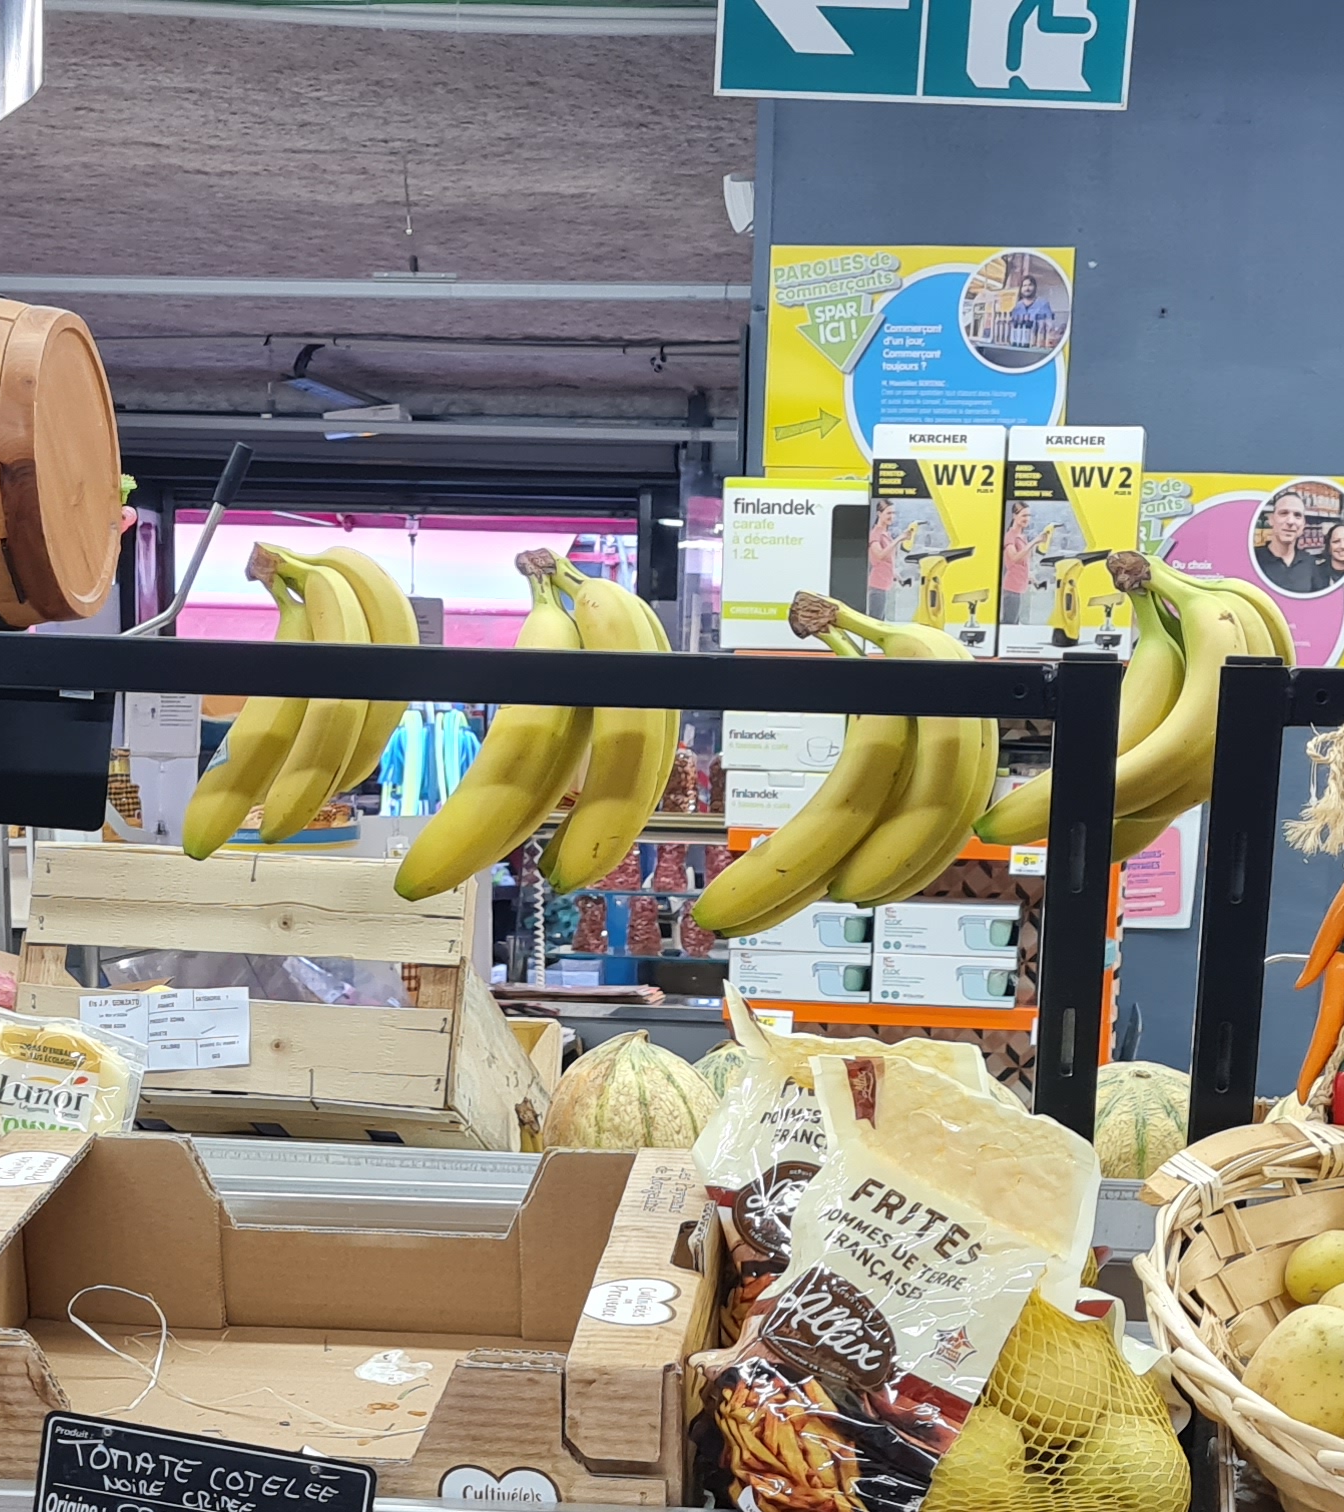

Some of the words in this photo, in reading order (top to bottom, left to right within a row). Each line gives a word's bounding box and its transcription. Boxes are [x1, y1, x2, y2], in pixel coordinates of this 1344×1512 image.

[774, 254, 863, 283] PAROLES
[870, 252, 890, 267] de
[775, 272, 894, 302] commerçants
[814, 302, 858, 323] SPAR
[884, 324, 943, 335] Commerçant
[883, 336, 904, 346] d'un
[883, 350, 942, 360] Commerçant
[882, 361, 919, 372] toujours
[981, 464, 995, 486] 2
[1118, 466, 1133, 488] 2
[734, 497, 816, 516] finlandek
[732, 519, 775, 530] carafe
[732, 533, 740, 545] à
[744, 534, 804, 545] décanter
[732, 549, 759, 560] 1.2L
[729, 728, 777, 741] finlandek
[732, 788, 778, 800] finlandek
[847, 1177, 984, 1267] FRITES
[823, 1228, 924, 1301] FRANÇAISES
[892, 1246, 920, 1272] DE
[919, 1262, 968, 1292] TERRE
[56, 1438, 202, 1484] TOMATE
